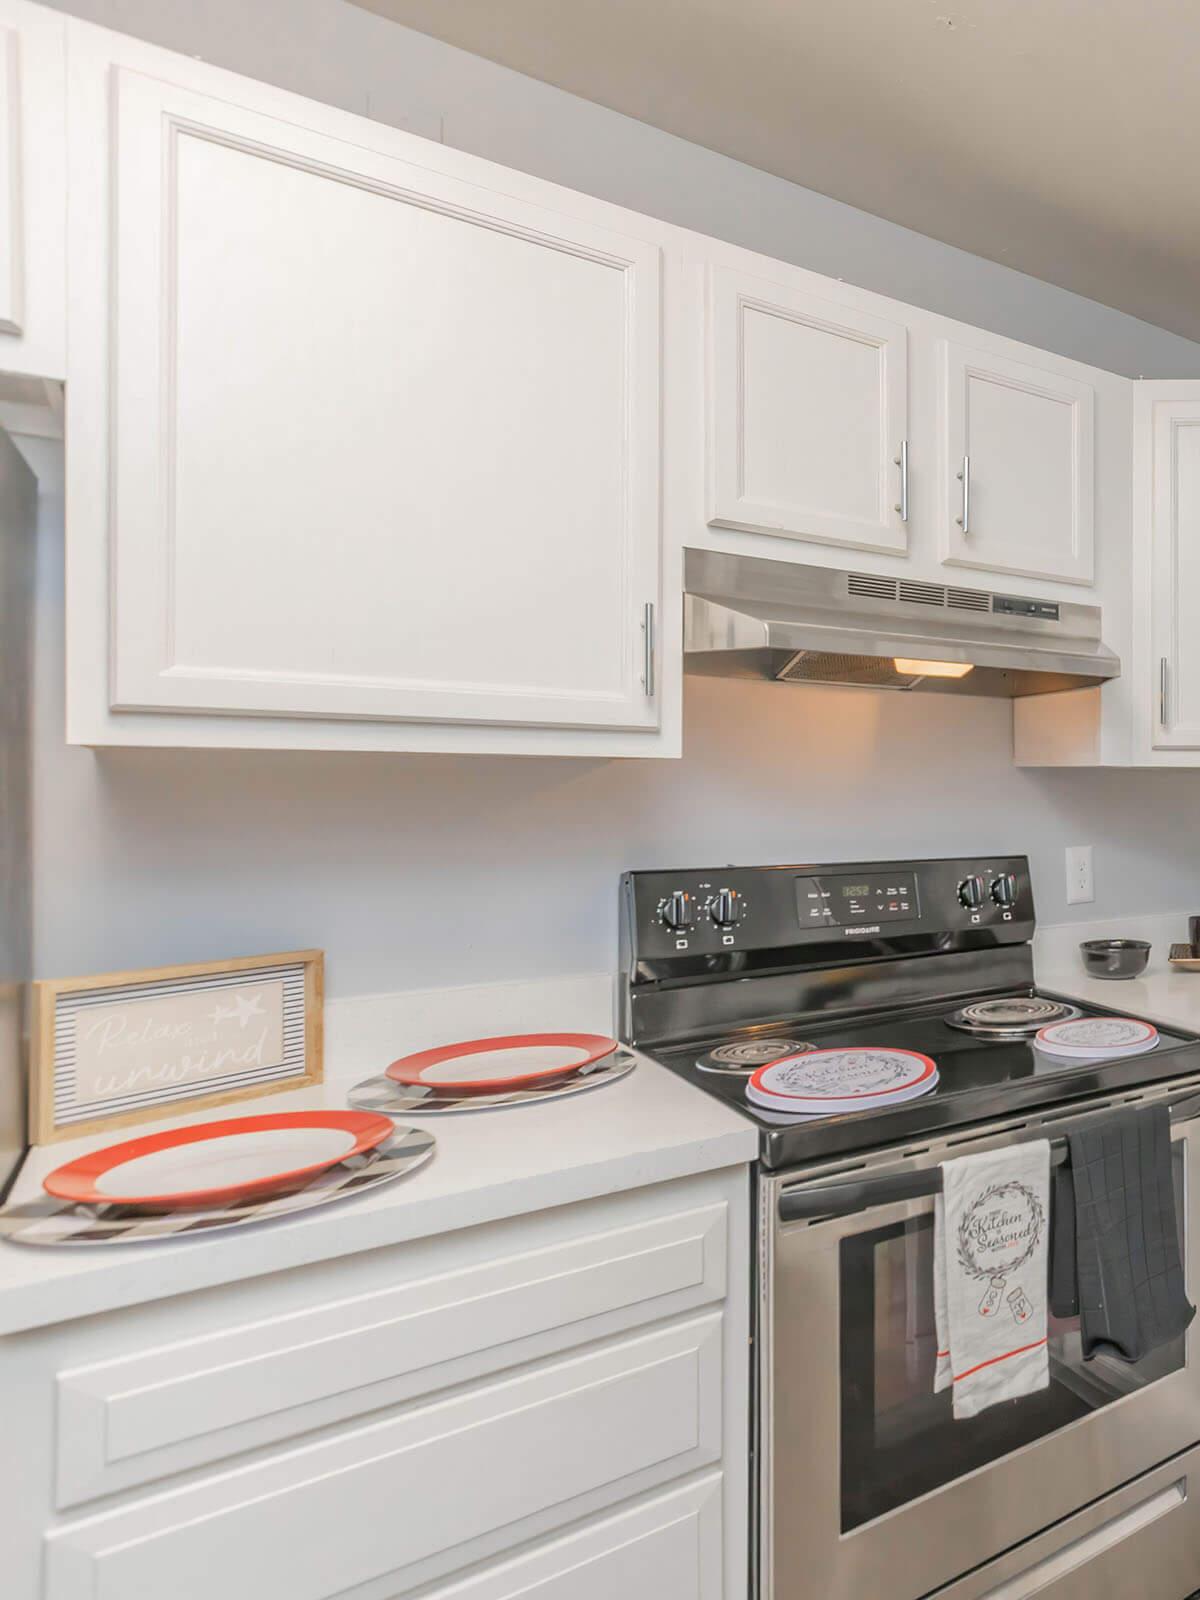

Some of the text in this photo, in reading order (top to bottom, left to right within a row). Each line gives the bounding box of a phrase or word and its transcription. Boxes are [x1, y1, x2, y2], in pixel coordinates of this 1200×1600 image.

[85, 1015, 191, 1055] Relax
[94, 1026, 268, 1094] unwind
[969, 1211, 1022, 1239] Kitchen
[977, 1222, 1031, 1253] Seasoned
